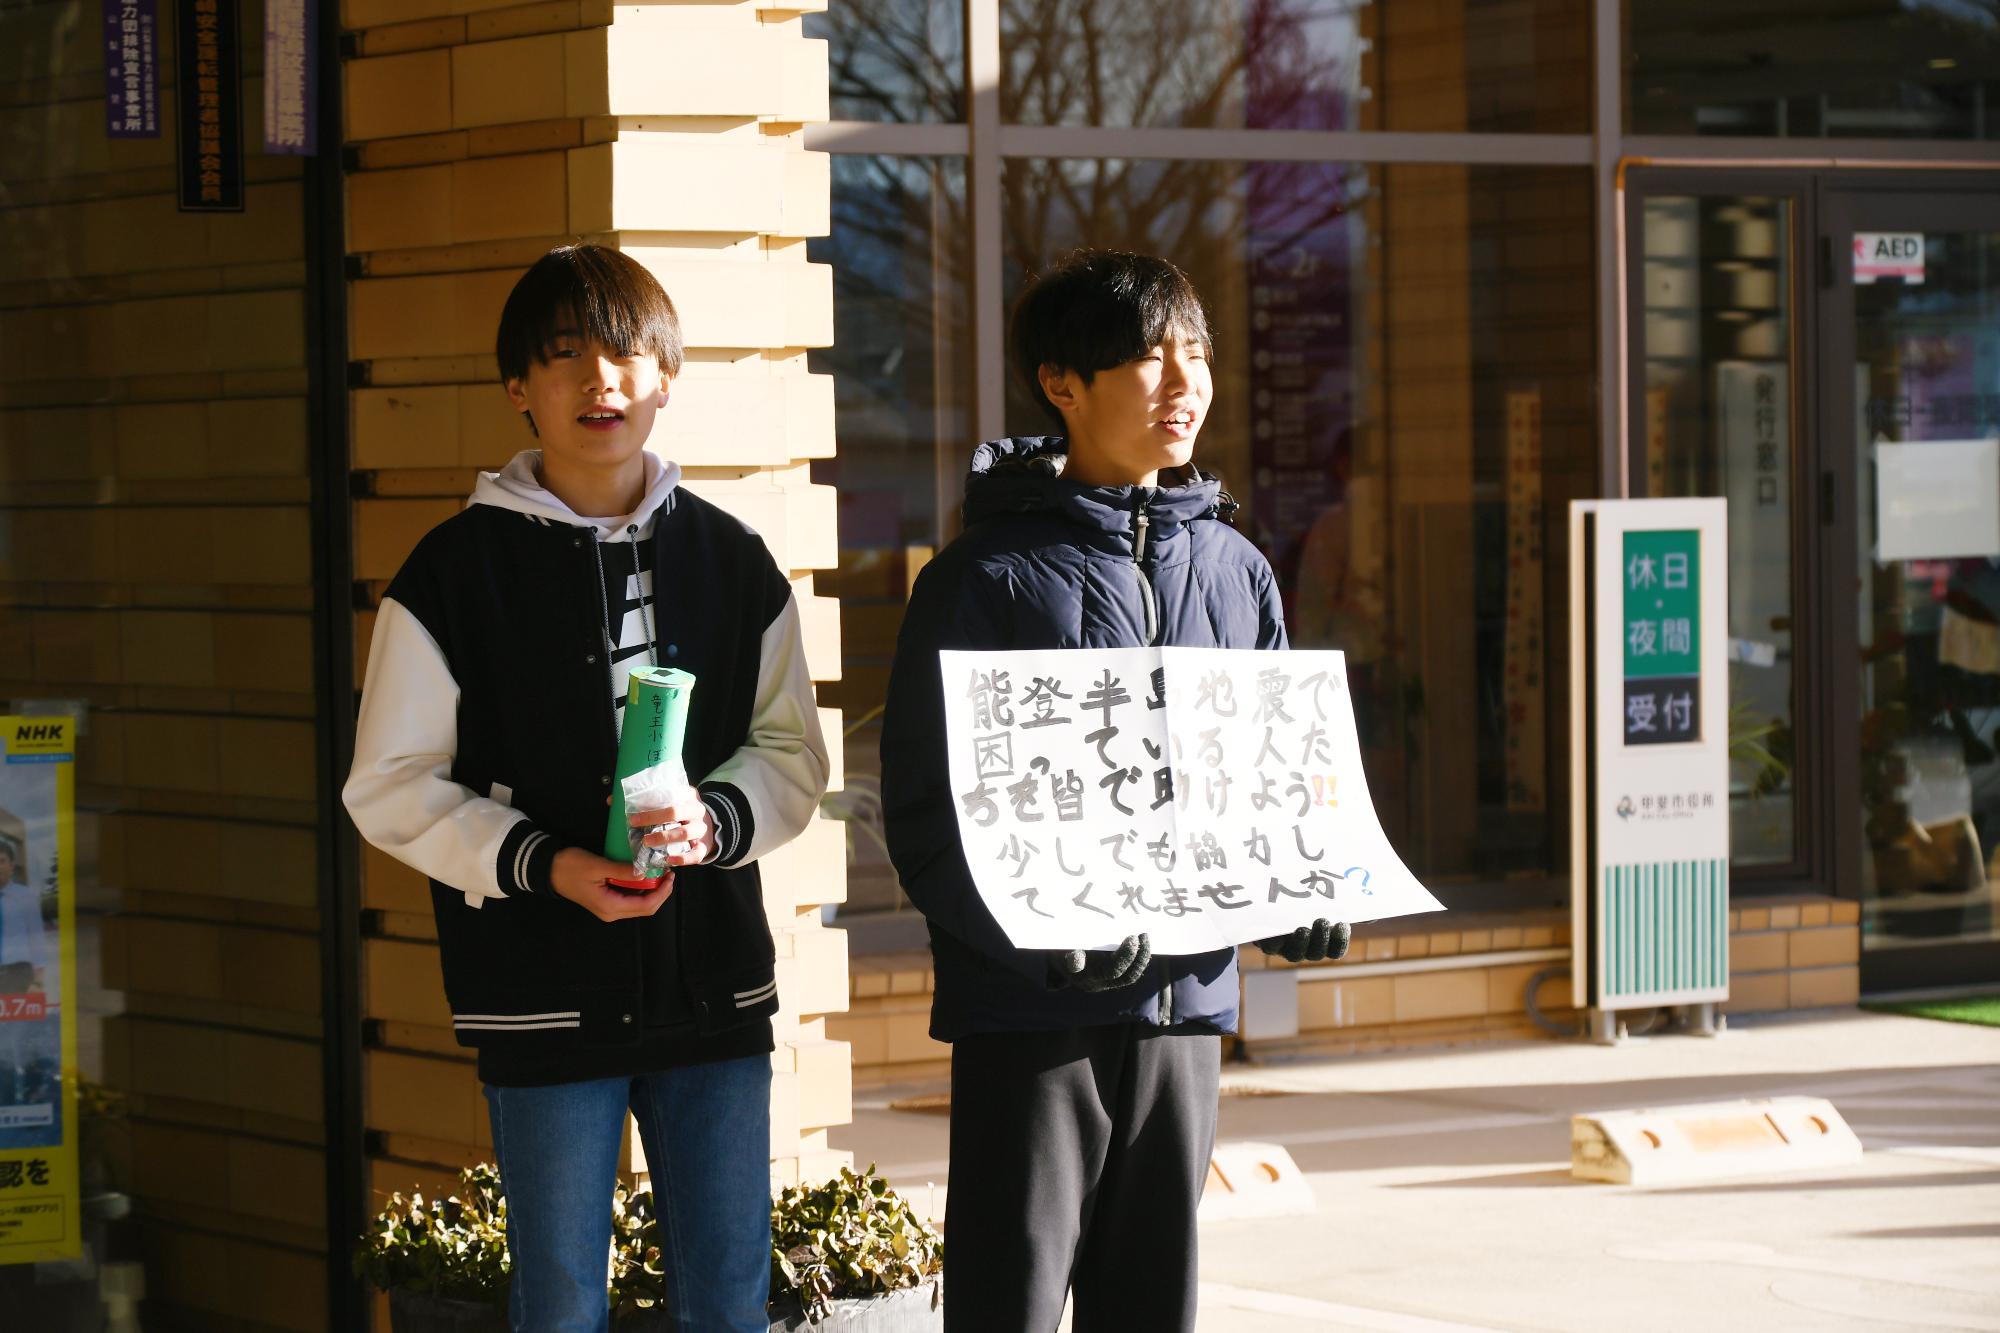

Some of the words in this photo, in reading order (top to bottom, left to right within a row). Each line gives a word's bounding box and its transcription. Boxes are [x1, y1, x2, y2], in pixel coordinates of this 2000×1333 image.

[1875, 237, 1918, 258] AED
[1628, 552, 1689, 591] 休日
[1629, 618, 1691, 656] 夜間
[965, 667, 1342, 731] 能登半島地震で
[1628, 692, 1693, 732] 受付
[15, 724, 64, 740] NHK
[972, 720, 1333, 780] 困っている人た
[997, 825, 1325, 879] 少しでも協力し
